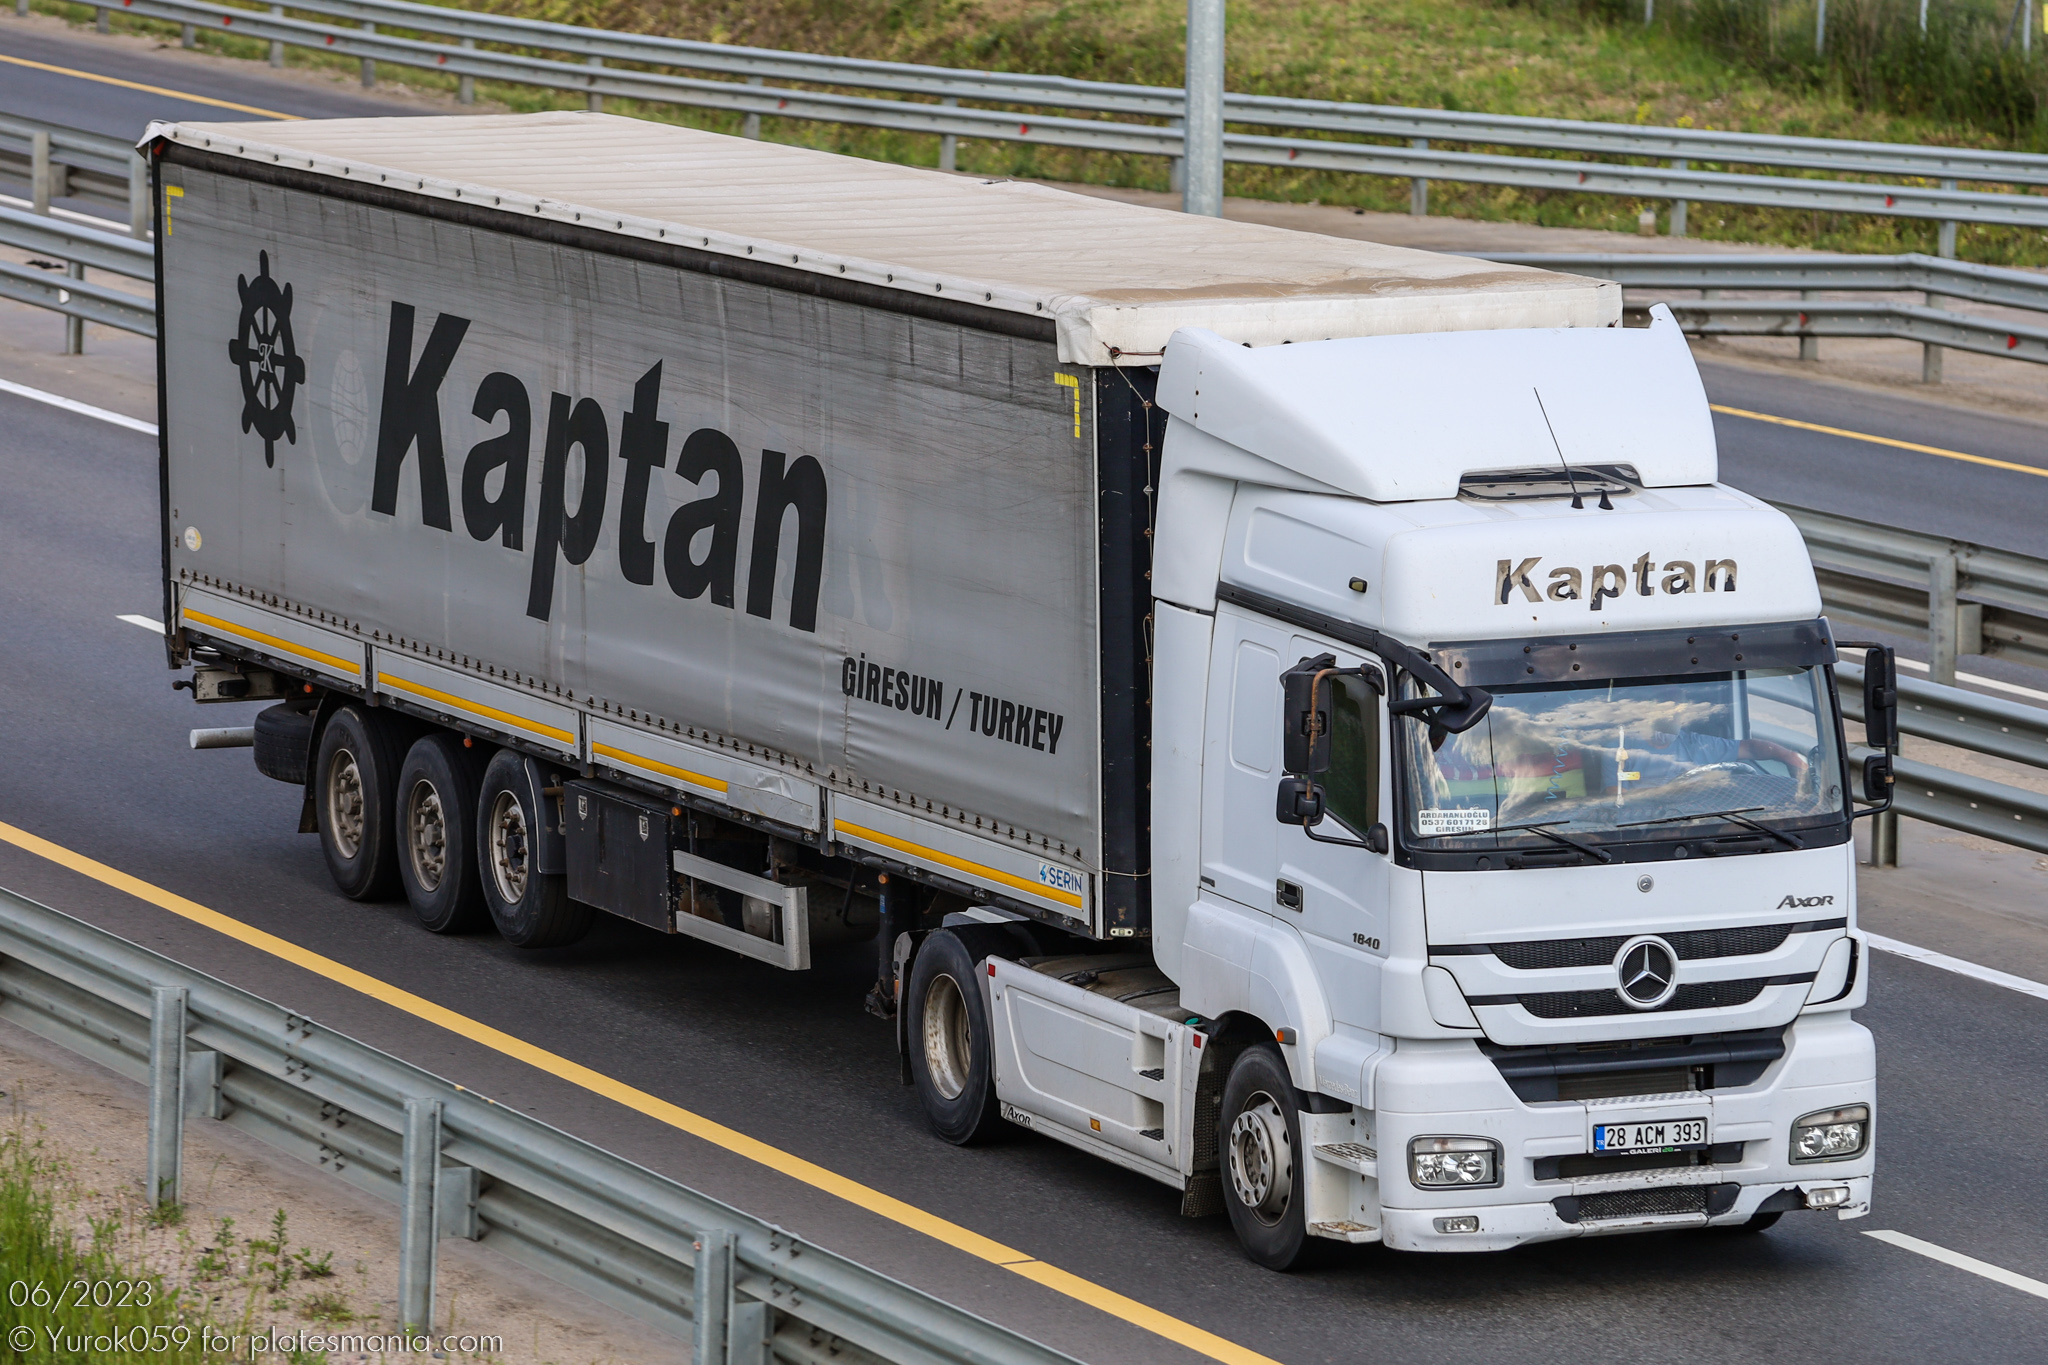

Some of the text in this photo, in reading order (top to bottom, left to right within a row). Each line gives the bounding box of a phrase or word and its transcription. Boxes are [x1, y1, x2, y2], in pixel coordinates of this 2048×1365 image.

[370, 301, 828, 633] Kaptan
[1494, 551, 1738, 611] Kaptan
[841, 652, 1064, 755] GİRESUN / TURKEY
[1049, 867, 1082, 892] SERIN
[1352, 932, 1380, 950] 1840
[1606, 1127, 1626, 1147] 28
[1634, 1125, 1665, 1145] ACM
[1673, 1123, 1702, 1142] 393
